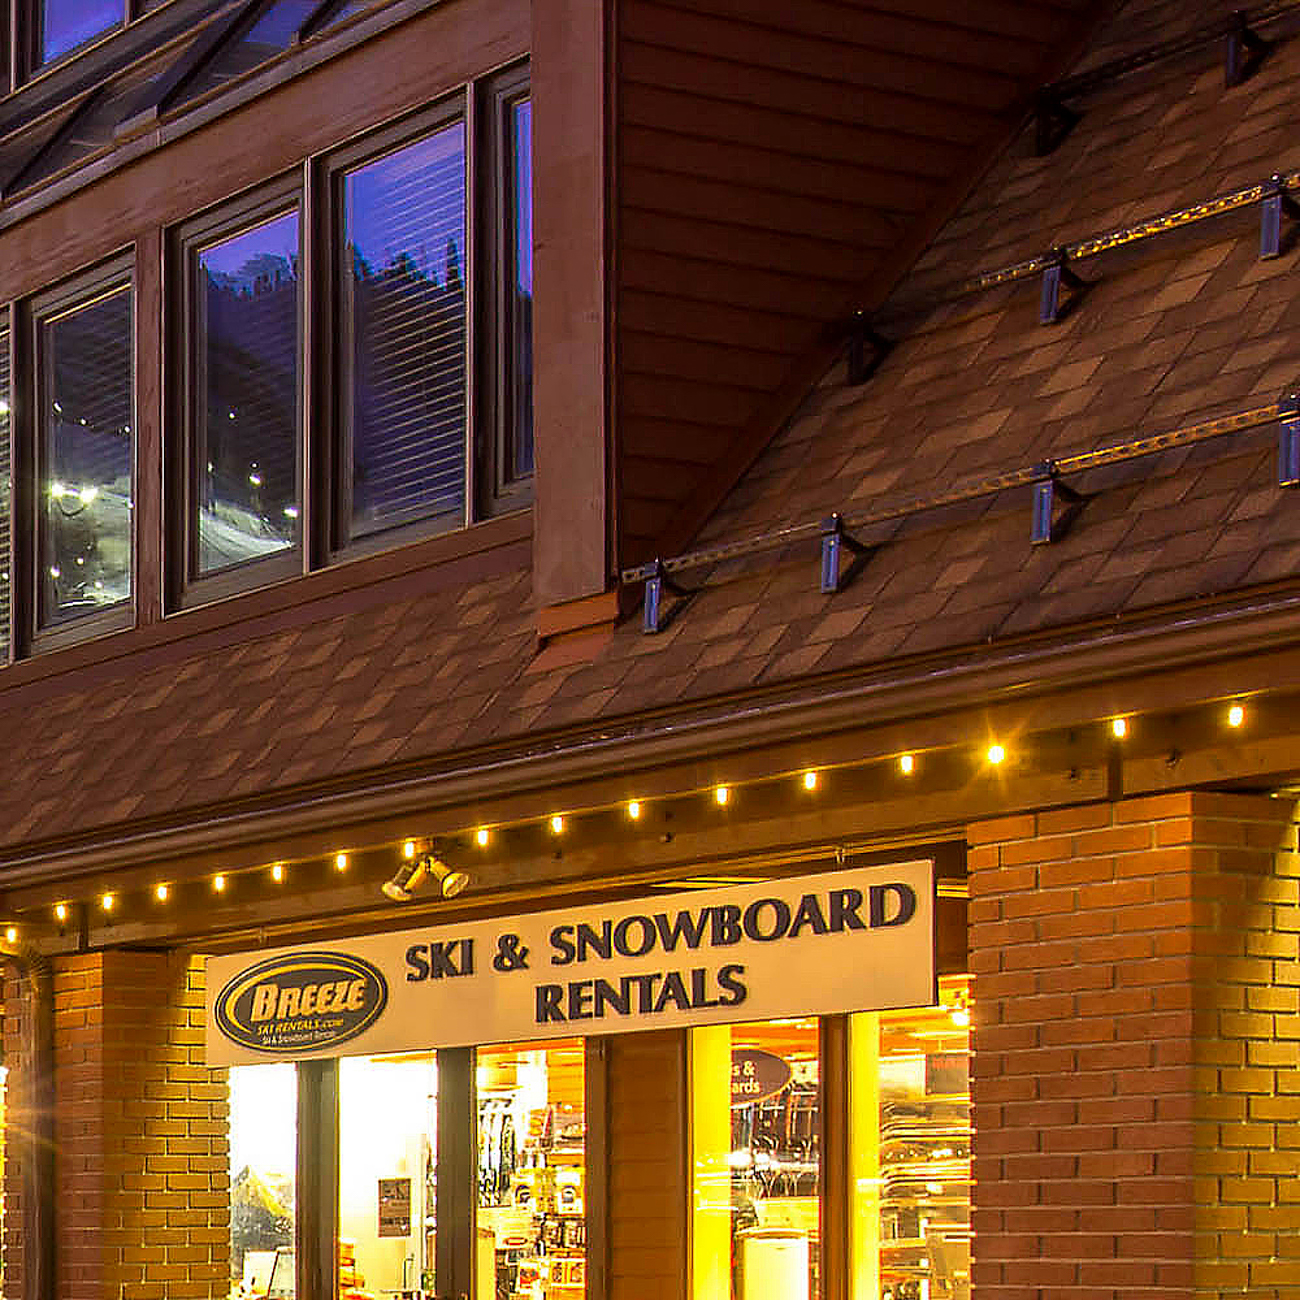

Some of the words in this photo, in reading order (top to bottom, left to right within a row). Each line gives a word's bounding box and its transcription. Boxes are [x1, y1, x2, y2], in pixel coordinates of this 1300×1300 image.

[405, 937, 476, 982] SKI
[492, 933, 530, 972] &
[550, 882, 917, 967] SNOWBOARD
[251, 976, 369, 1022] BREEZE
[535, 964, 749, 1024] RENTALS
